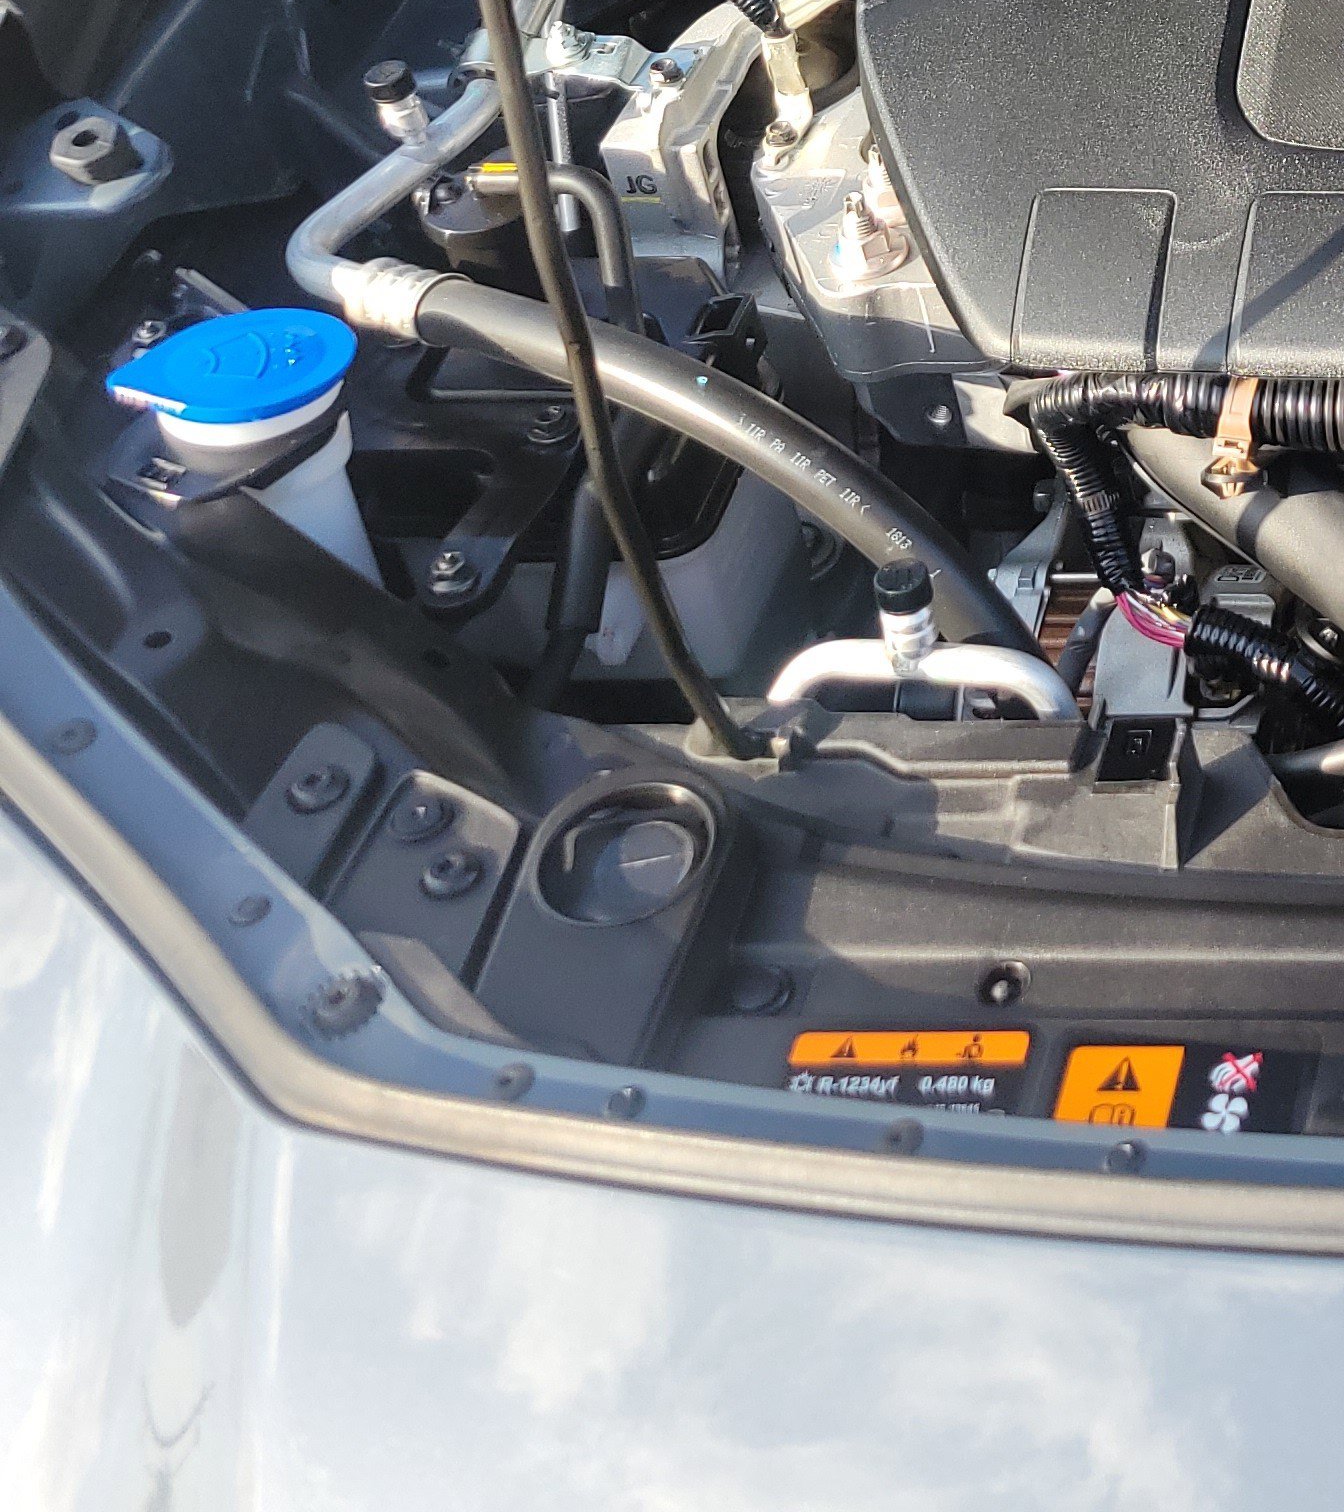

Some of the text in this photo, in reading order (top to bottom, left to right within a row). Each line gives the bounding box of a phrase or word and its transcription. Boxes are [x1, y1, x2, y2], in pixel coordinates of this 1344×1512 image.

[626, 174, 658, 195] JG
[769, 438, 786, 454] PA
[814, 469, 837, 487] PET
[970, 1075, 996, 1097] kg
